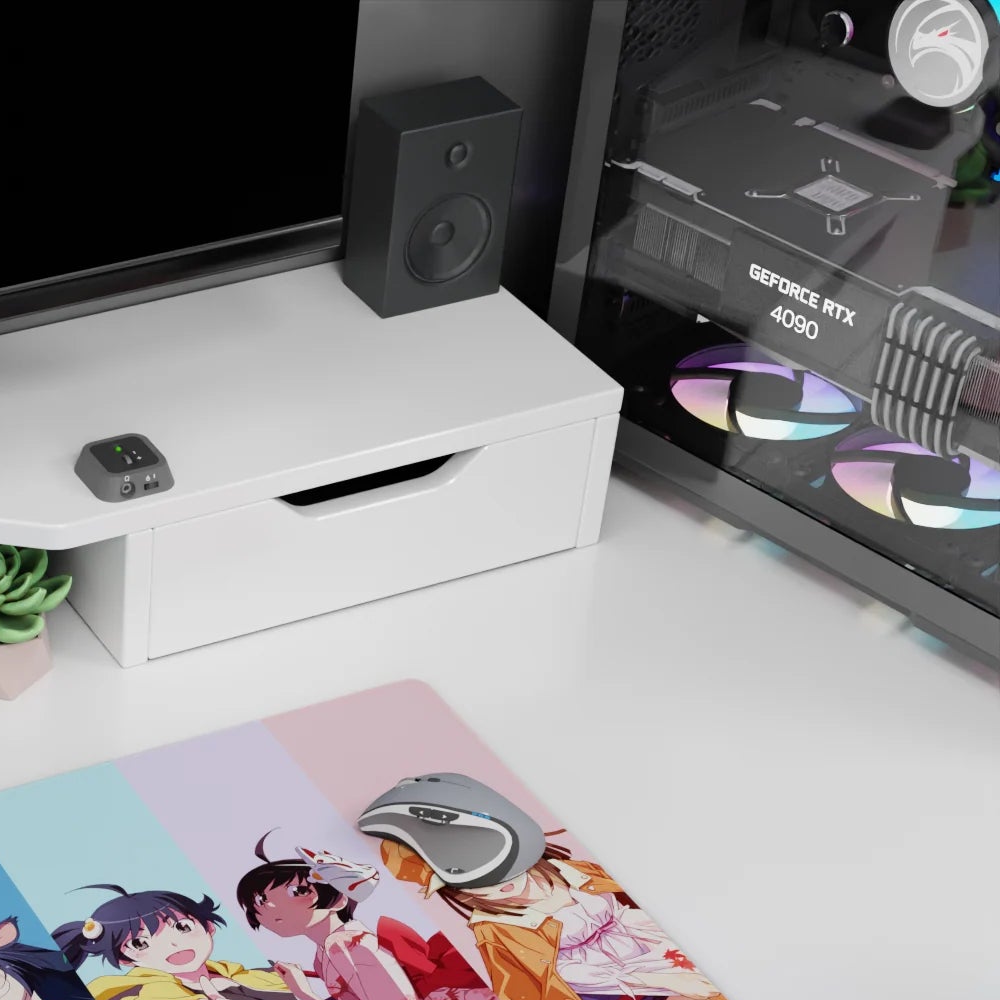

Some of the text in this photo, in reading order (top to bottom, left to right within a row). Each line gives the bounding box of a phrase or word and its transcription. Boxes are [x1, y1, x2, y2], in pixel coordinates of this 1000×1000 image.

[749, 263, 856, 328] GEFORCE RTX
[770, 305, 819, 340] 4090
